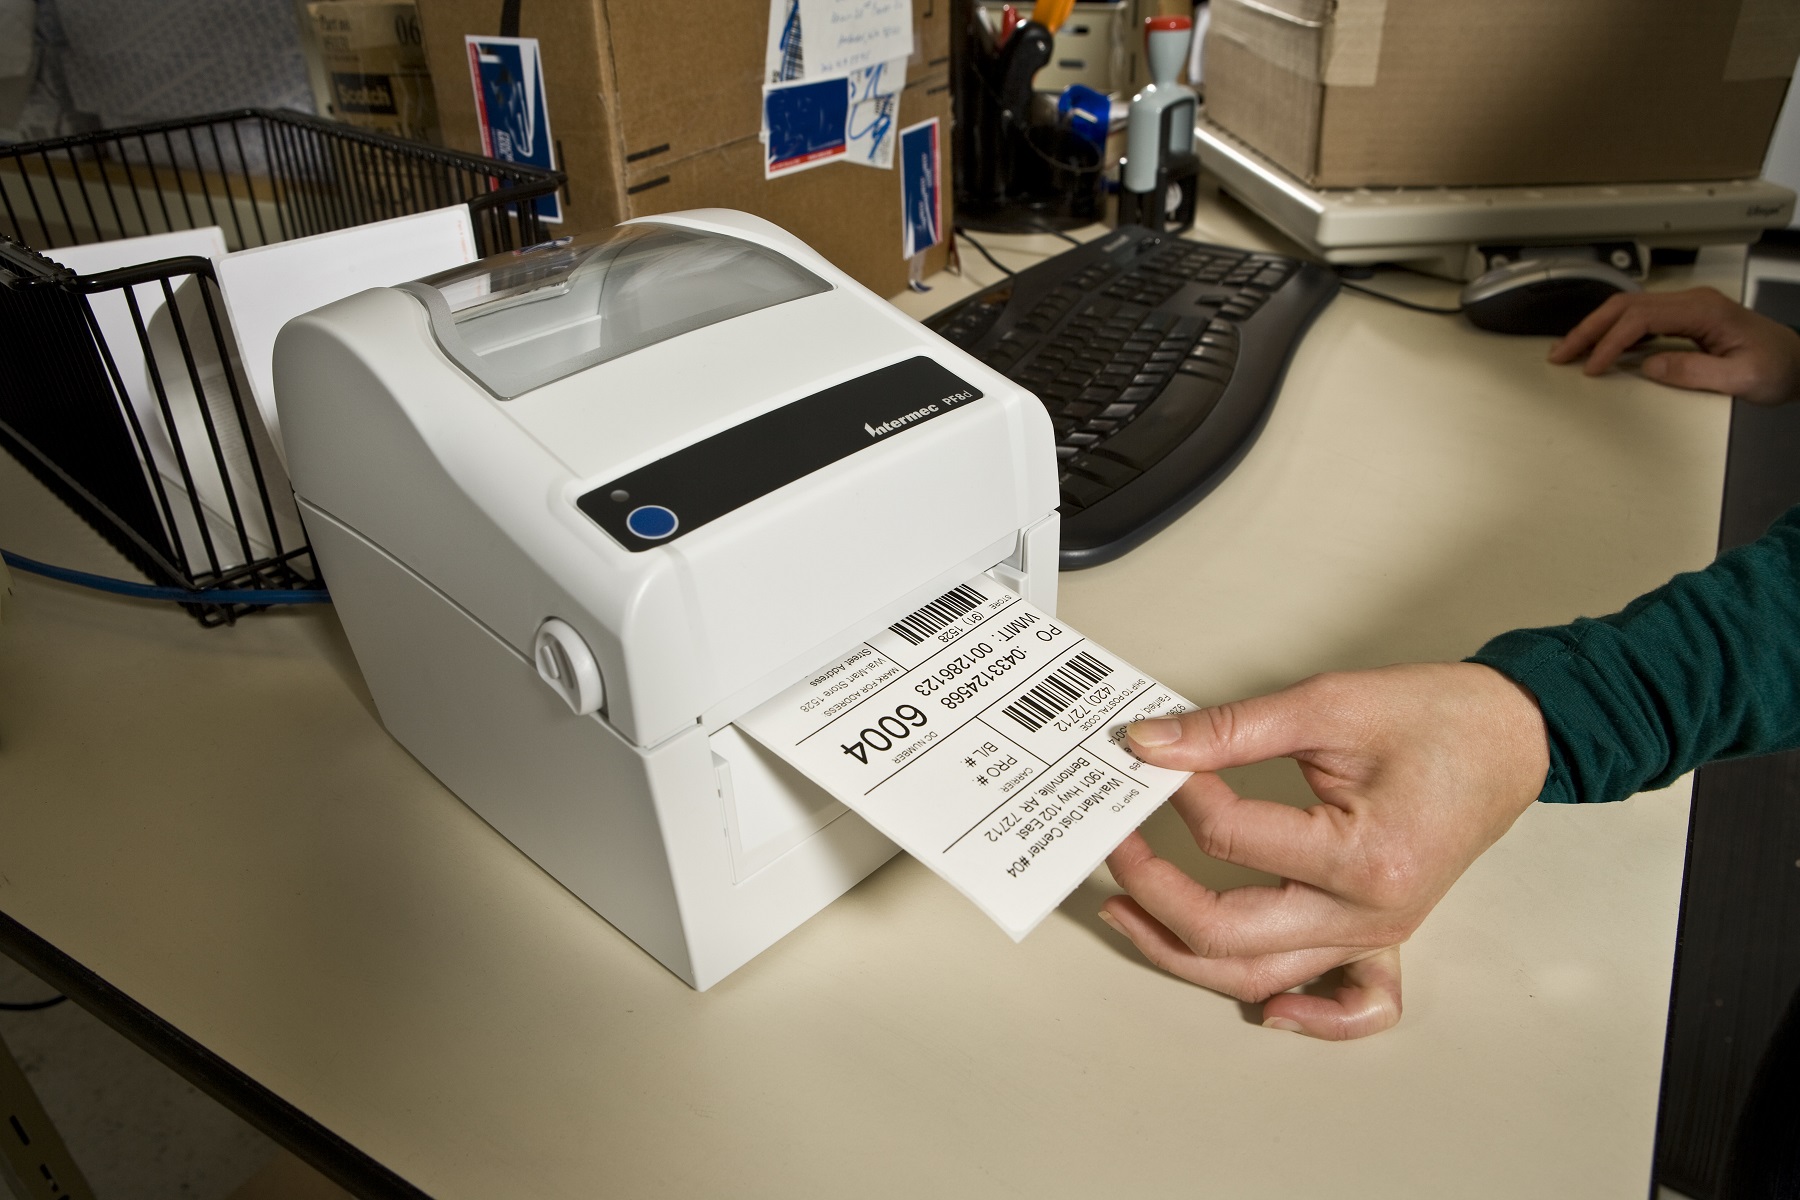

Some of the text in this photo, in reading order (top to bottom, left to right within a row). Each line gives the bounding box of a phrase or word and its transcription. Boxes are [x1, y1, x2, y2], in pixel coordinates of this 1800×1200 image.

[337, 82, 392, 107] Scotch
[864, 390, 973, 438] Intermec PF8d
[988, 594, 1012, 610] STORE
[938, 610, 985, 643] (91) 1528
[1036, 624, 1063, 642] PO
[809, 648, 872, 687] Street Address
[875, 667, 900, 683] MARK
[914, 642, 994, 697] 001286123
[800, 657, 886, 713] Wal-Mart Store 1528
[860, 680, 878, 694] FOR
[1121, 688, 1133, 698] TO
[1132, 678, 1147, 690] SHIP
[1053, 682, 1116, 732] (420) 72712
[1099, 695, 1125, 715] POSTAL
[840, 704, 928, 765] 6004
[892, 730, 939, 764] DC NUMBER
[1107, 725, 1128, 746] 5014
[972, 741, 999, 758] B/L
[986, 753, 1018, 778] PRO
[984, 756, 1091, 843] Bentonville, AR 72712
[1016, 768, 1106, 840] 1901 Hwy 102 East
[1123, 788, 1140, 804] SHIP
[1006, 777, 1124, 879] Wal-Mart Dist Center #04
